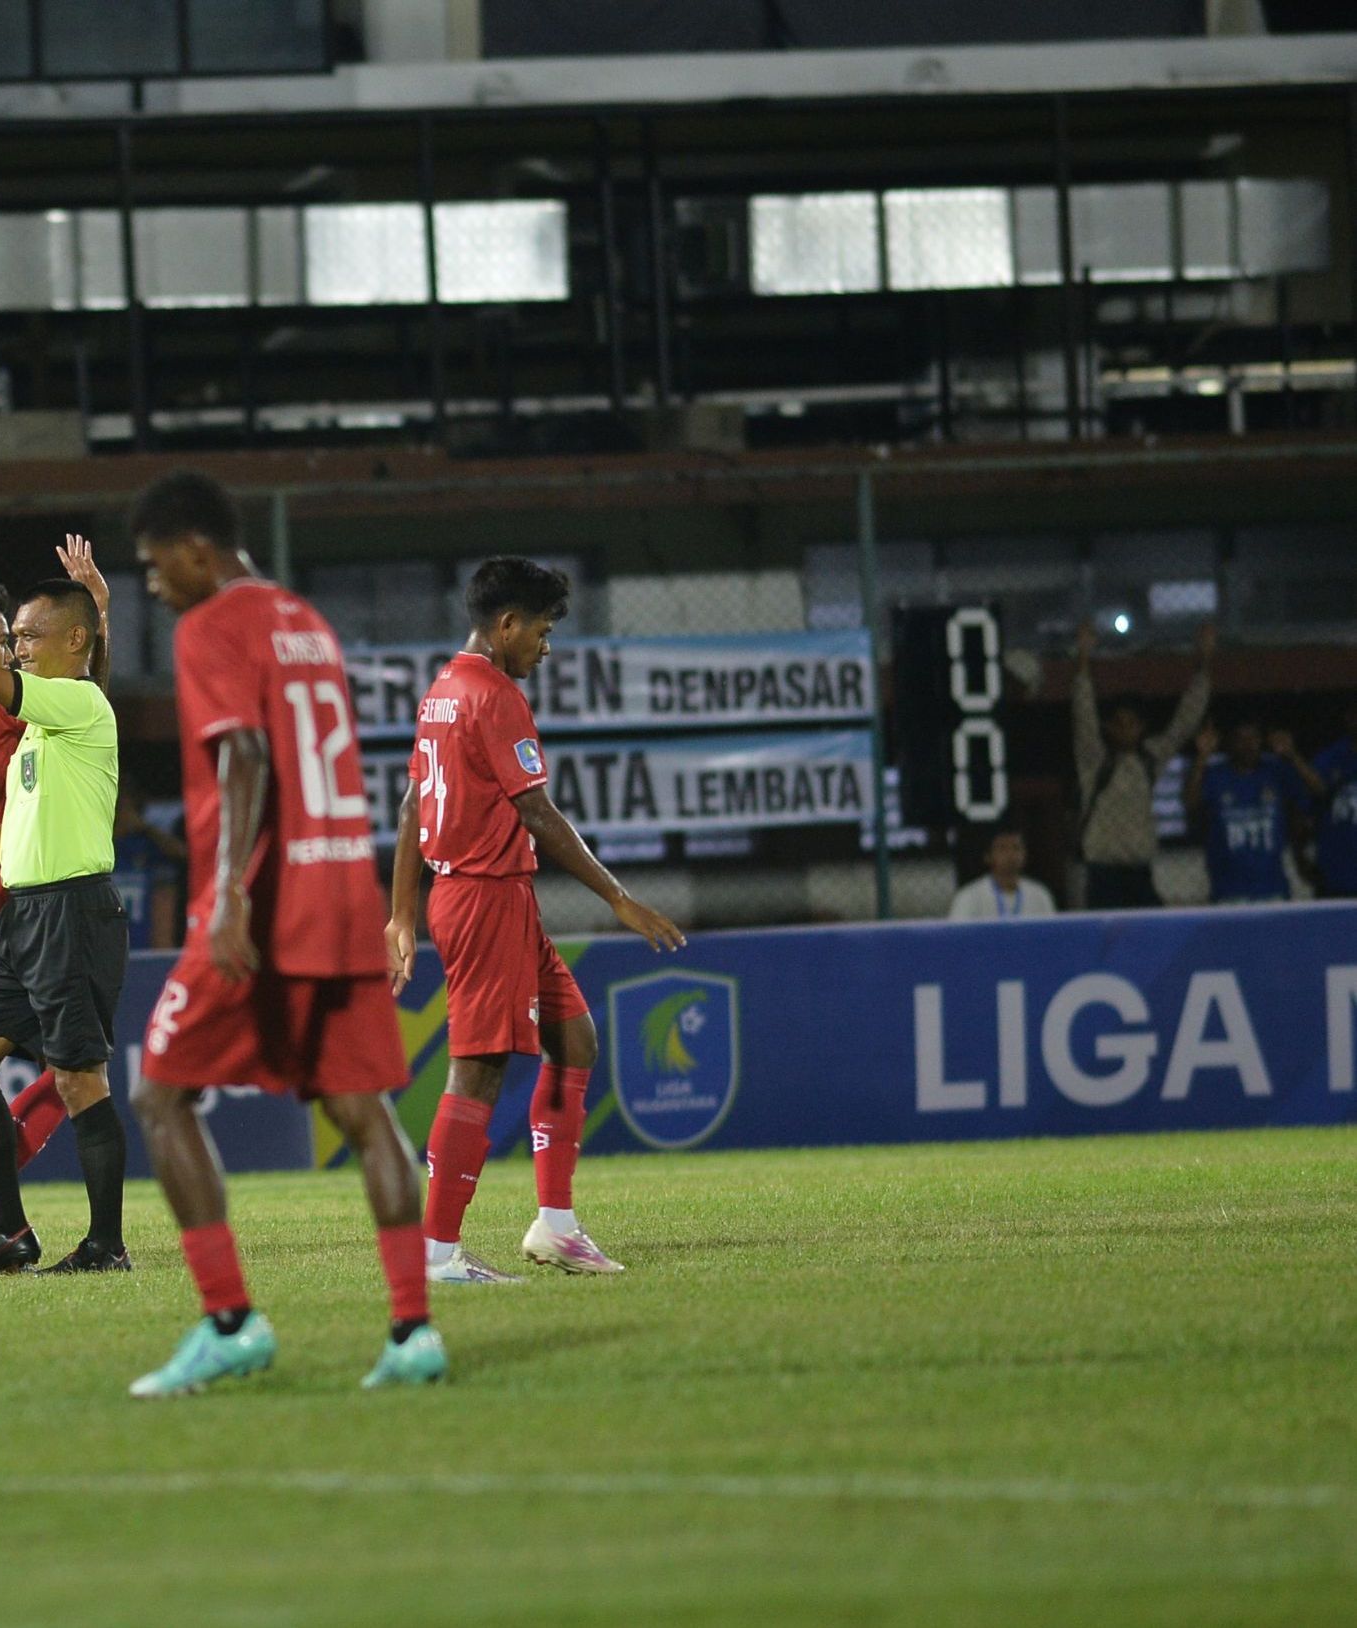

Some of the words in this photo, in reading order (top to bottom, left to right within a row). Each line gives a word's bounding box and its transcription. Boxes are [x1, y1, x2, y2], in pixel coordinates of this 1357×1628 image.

[648, 660, 863, 713] DENPASAR
[285, 681, 370, 819] 12
[674, 763, 862, 818] LEMBATA
[913, 970, 1273, 1112] LIGA
